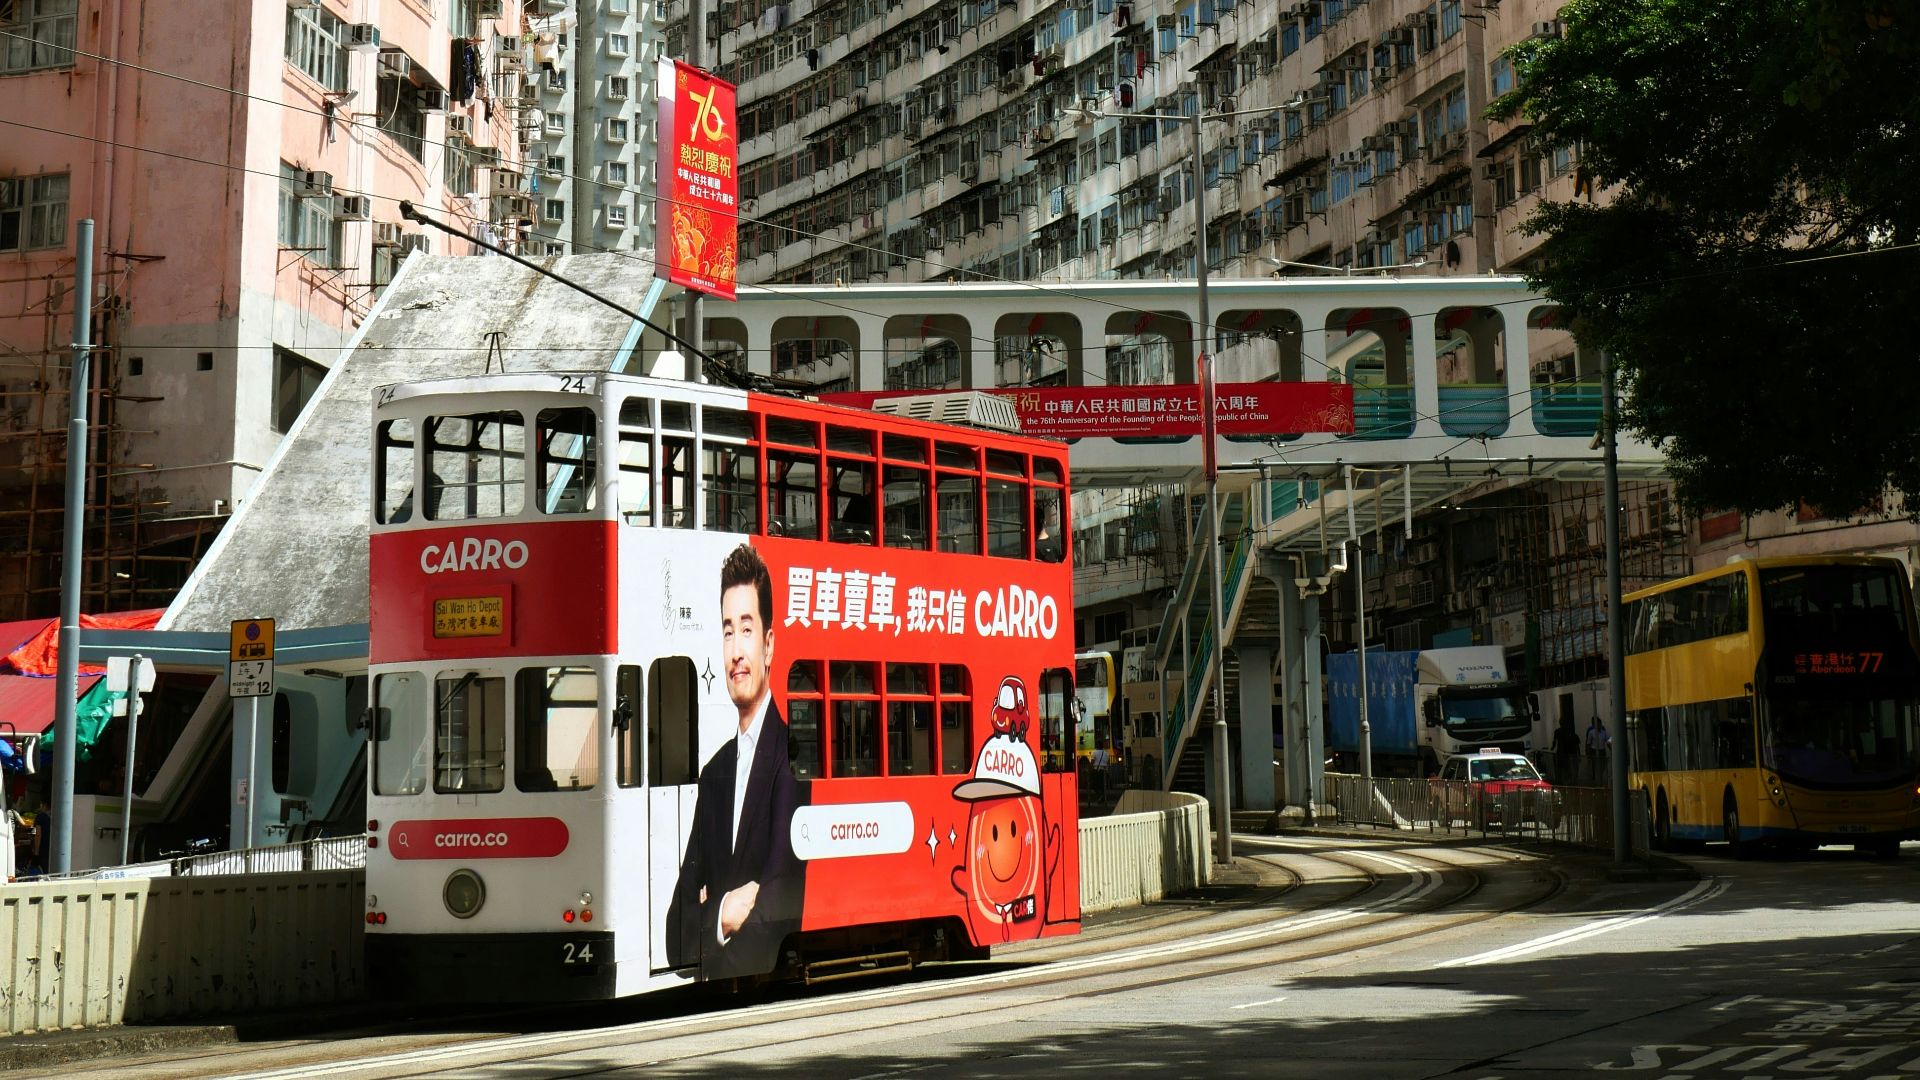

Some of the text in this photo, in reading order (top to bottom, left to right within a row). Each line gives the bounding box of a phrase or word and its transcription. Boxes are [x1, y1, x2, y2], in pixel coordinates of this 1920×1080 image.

[689, 85, 722, 142] 76
[680, 143, 732, 178] 熱烈慶祝
[677, 167, 721, 190] 中華人民共和國
[689, 184, 734, 206] 成立七十六周年
[560, 376, 586, 394] 24
[377, 387, 396, 409] 24
[1045, 396, 1259, 415] 中華人民共和國成立七六周年
[1027, 417, 1039, 425] the
[1040, 416, 1056, 425] 76th
[1058, 416, 1099, 426] Anniversary
[1100, 415, 1108, 424] of
[1110, 415, 1121, 424] the
[1123, 414, 1155, 424] Founding
[1156, 414, 1164, 423] of
[1166, 414, 1177, 423] the
[1215, 412, 1239, 422] epublic
[1240, 412, 1248, 421] of
[1250, 412, 1269, 421] China
[420, 537, 529, 574] CARRO
[436, 599, 500, 615] Sai Wan Ho Depot
[974, 584, 1058, 640] CARRO
[236, 668, 251, 676] 上午
[257, 662, 264, 674] 7
[1810, 665, 1856, 674] Aberdeen
[1858, 652, 1884, 673] 77
[257, 681, 270, 693] 12
[984, 750, 1024, 778] CARRO
[434, 832, 509, 847] carro.co
[830, 821, 880, 841] carro.co
[563, 942, 594, 964] 24
